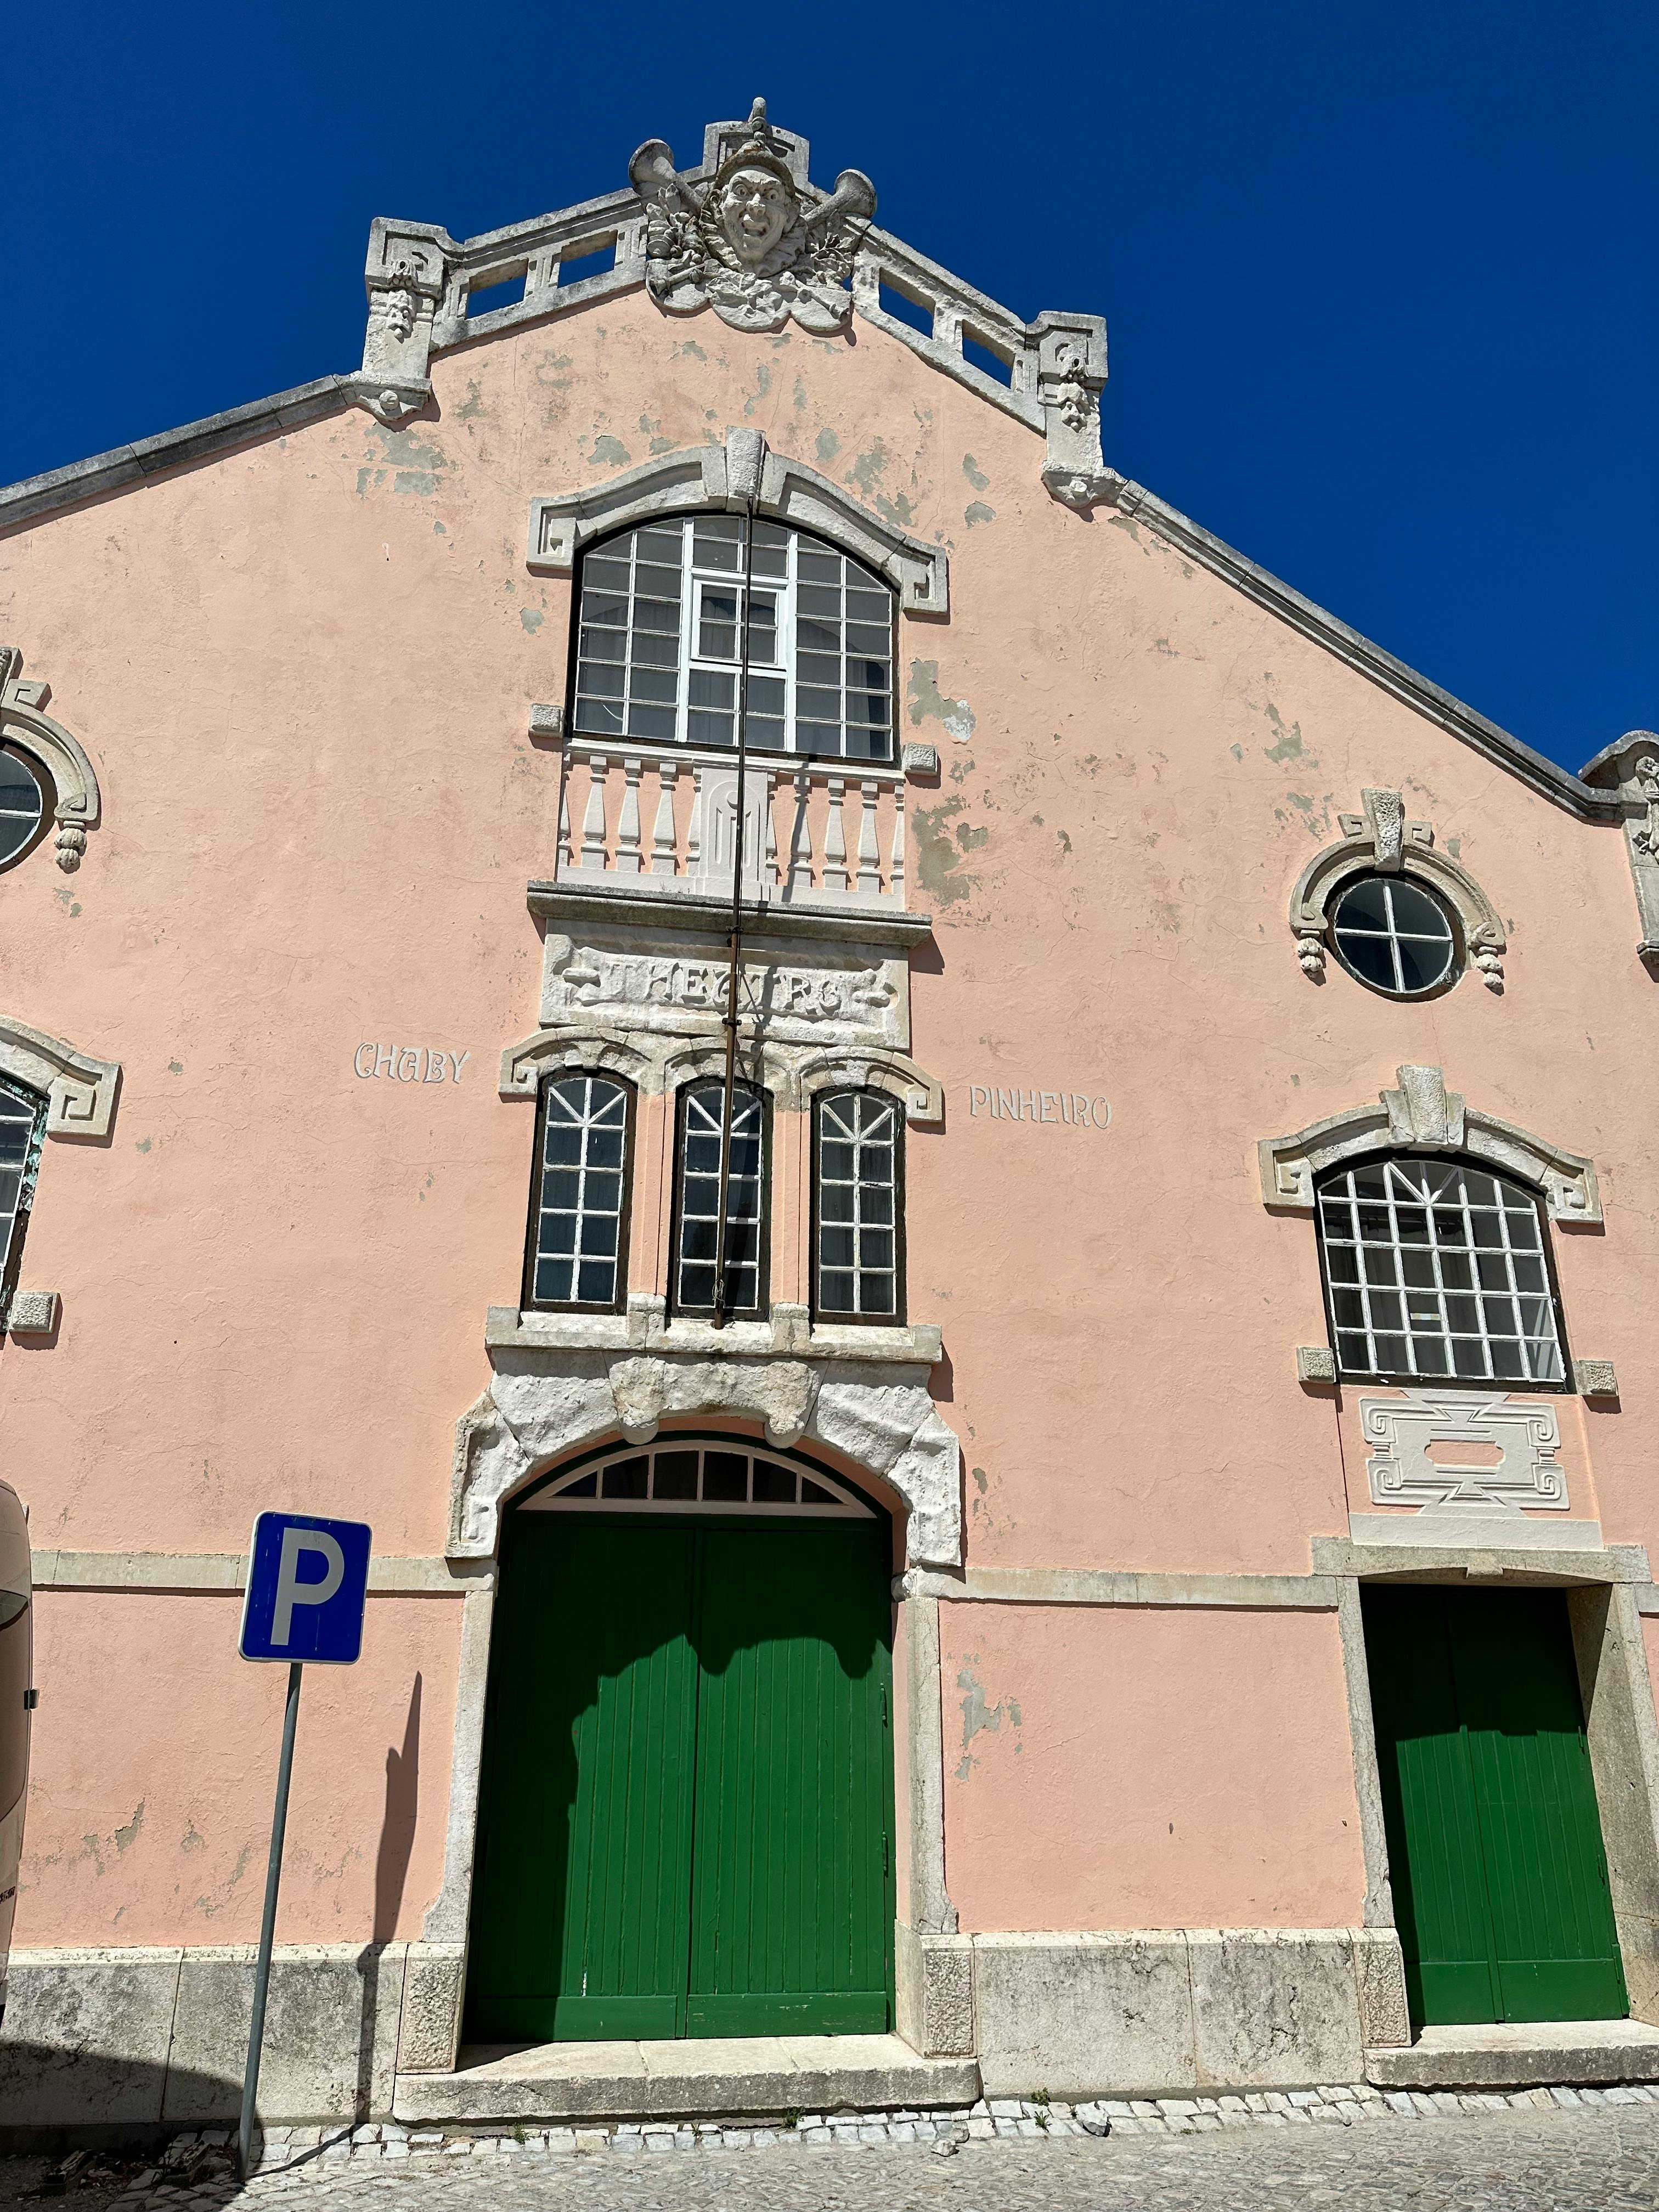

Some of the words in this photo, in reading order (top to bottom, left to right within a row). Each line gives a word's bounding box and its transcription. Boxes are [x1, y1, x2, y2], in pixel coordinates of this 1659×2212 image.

[354, 1042, 472, 1084] CHABY
[969, 1085, 1112, 1129] PINHEIRO
[270, 1527, 345, 1645] P
